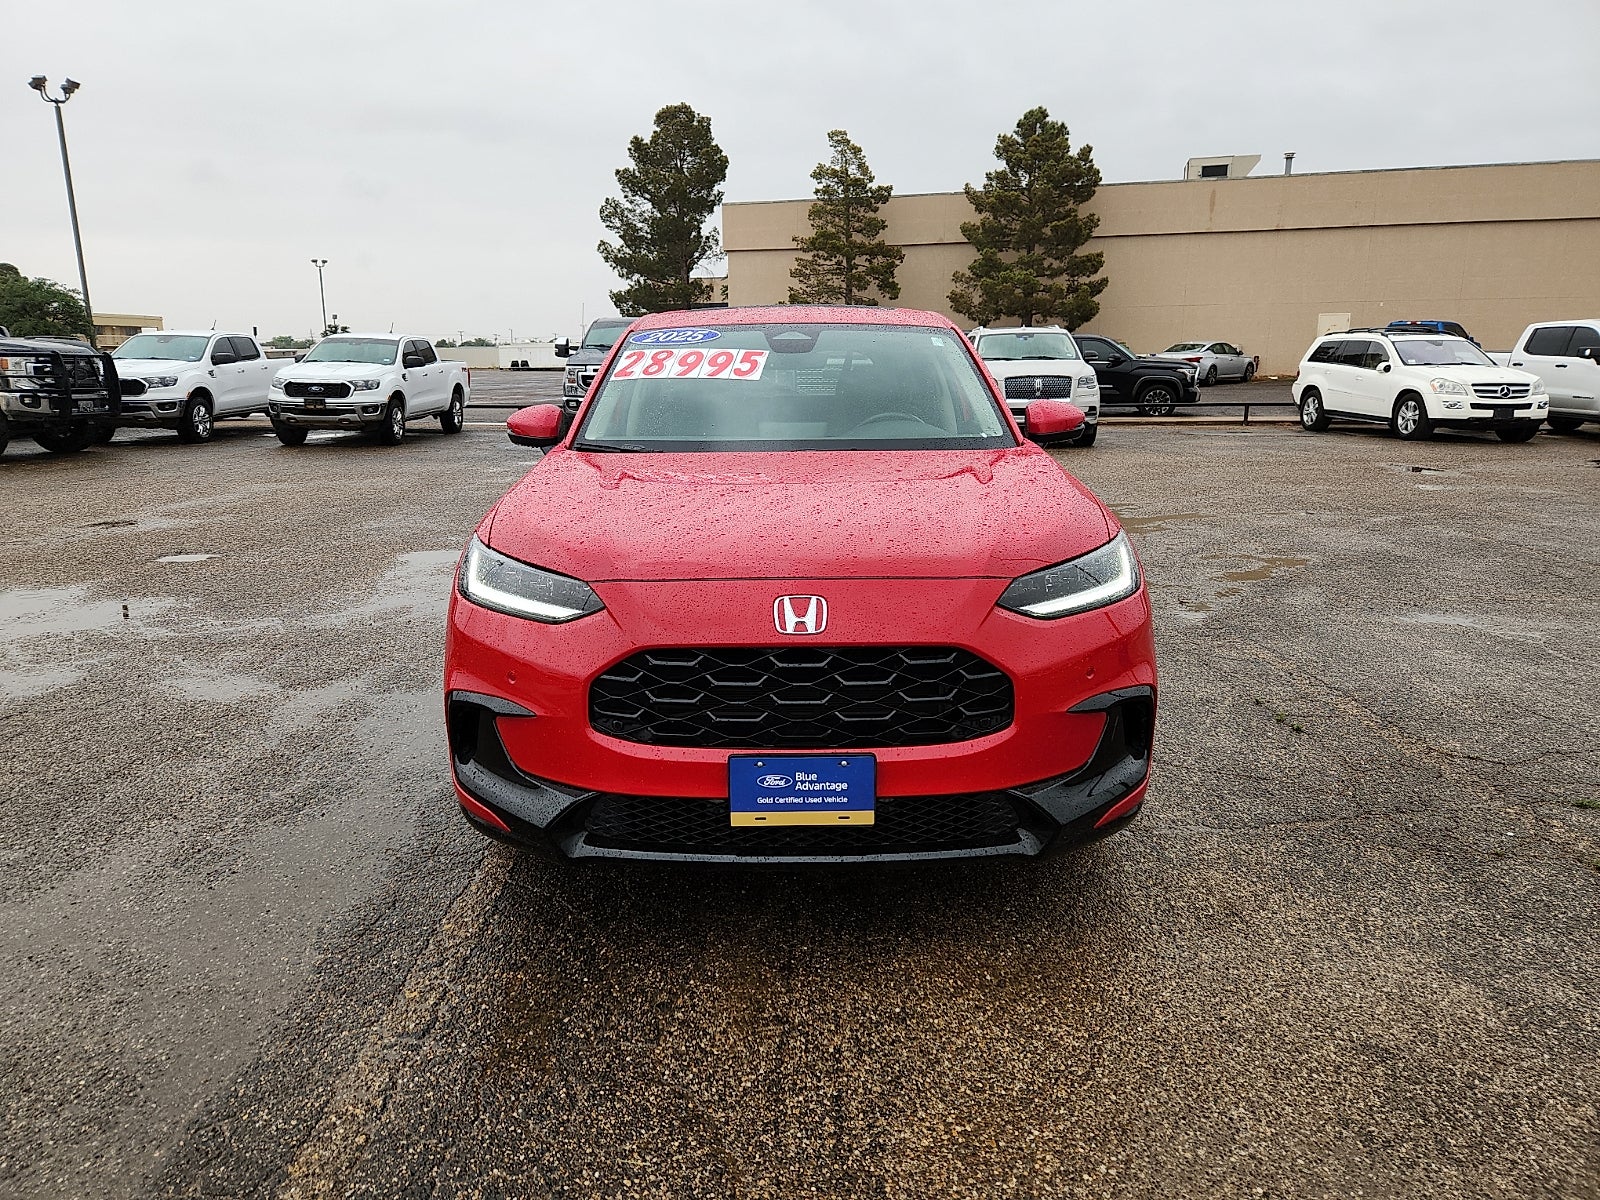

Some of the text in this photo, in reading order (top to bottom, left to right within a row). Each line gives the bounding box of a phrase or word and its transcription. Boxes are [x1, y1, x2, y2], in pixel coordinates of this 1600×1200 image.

[644, 330, 704, 342] 2025
[613, 350, 765, 377] 28995
[763, 776, 786, 786] Ford
[795, 772, 817, 781] Blue
[795, 781, 848, 792] Advantage
[757, 796, 773, 804] Gold
[774, 796, 803, 804] Certified
[804, 796, 822, 804] Used
